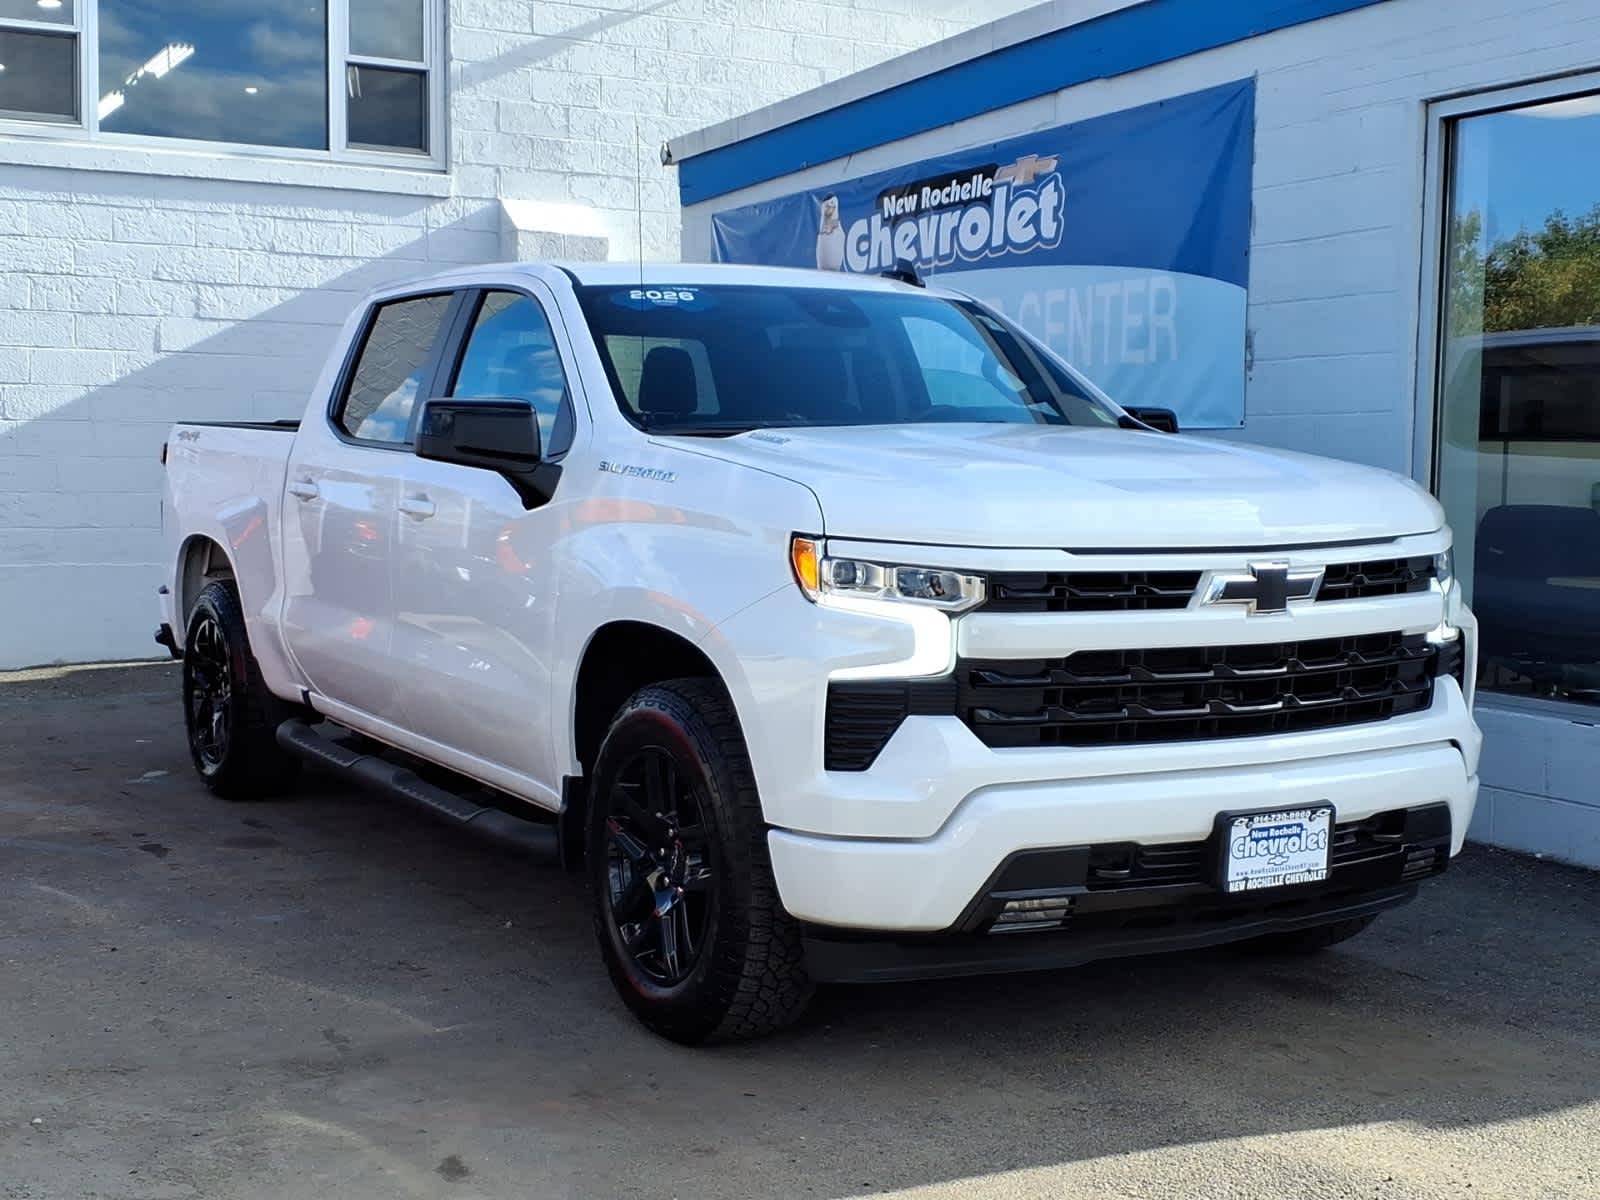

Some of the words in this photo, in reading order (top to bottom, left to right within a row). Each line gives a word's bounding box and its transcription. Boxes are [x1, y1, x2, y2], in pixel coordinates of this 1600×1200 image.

[883, 194, 917, 219] New
[921, 172, 993, 210] Rochelle
[845, 177, 1062, 272] Chevrolet
[630, 289, 695, 301] 2026
[1231, 828, 1327, 860] Chevrolet
[1251, 828, 1269, 840] New
[1269, 825, 1302, 838] Rochelle
[1229, 879, 1246, 893] NEW
[1246, 873, 1285, 890] ROCHELLE
[1285, 869, 1328, 886] CHEVROLET
